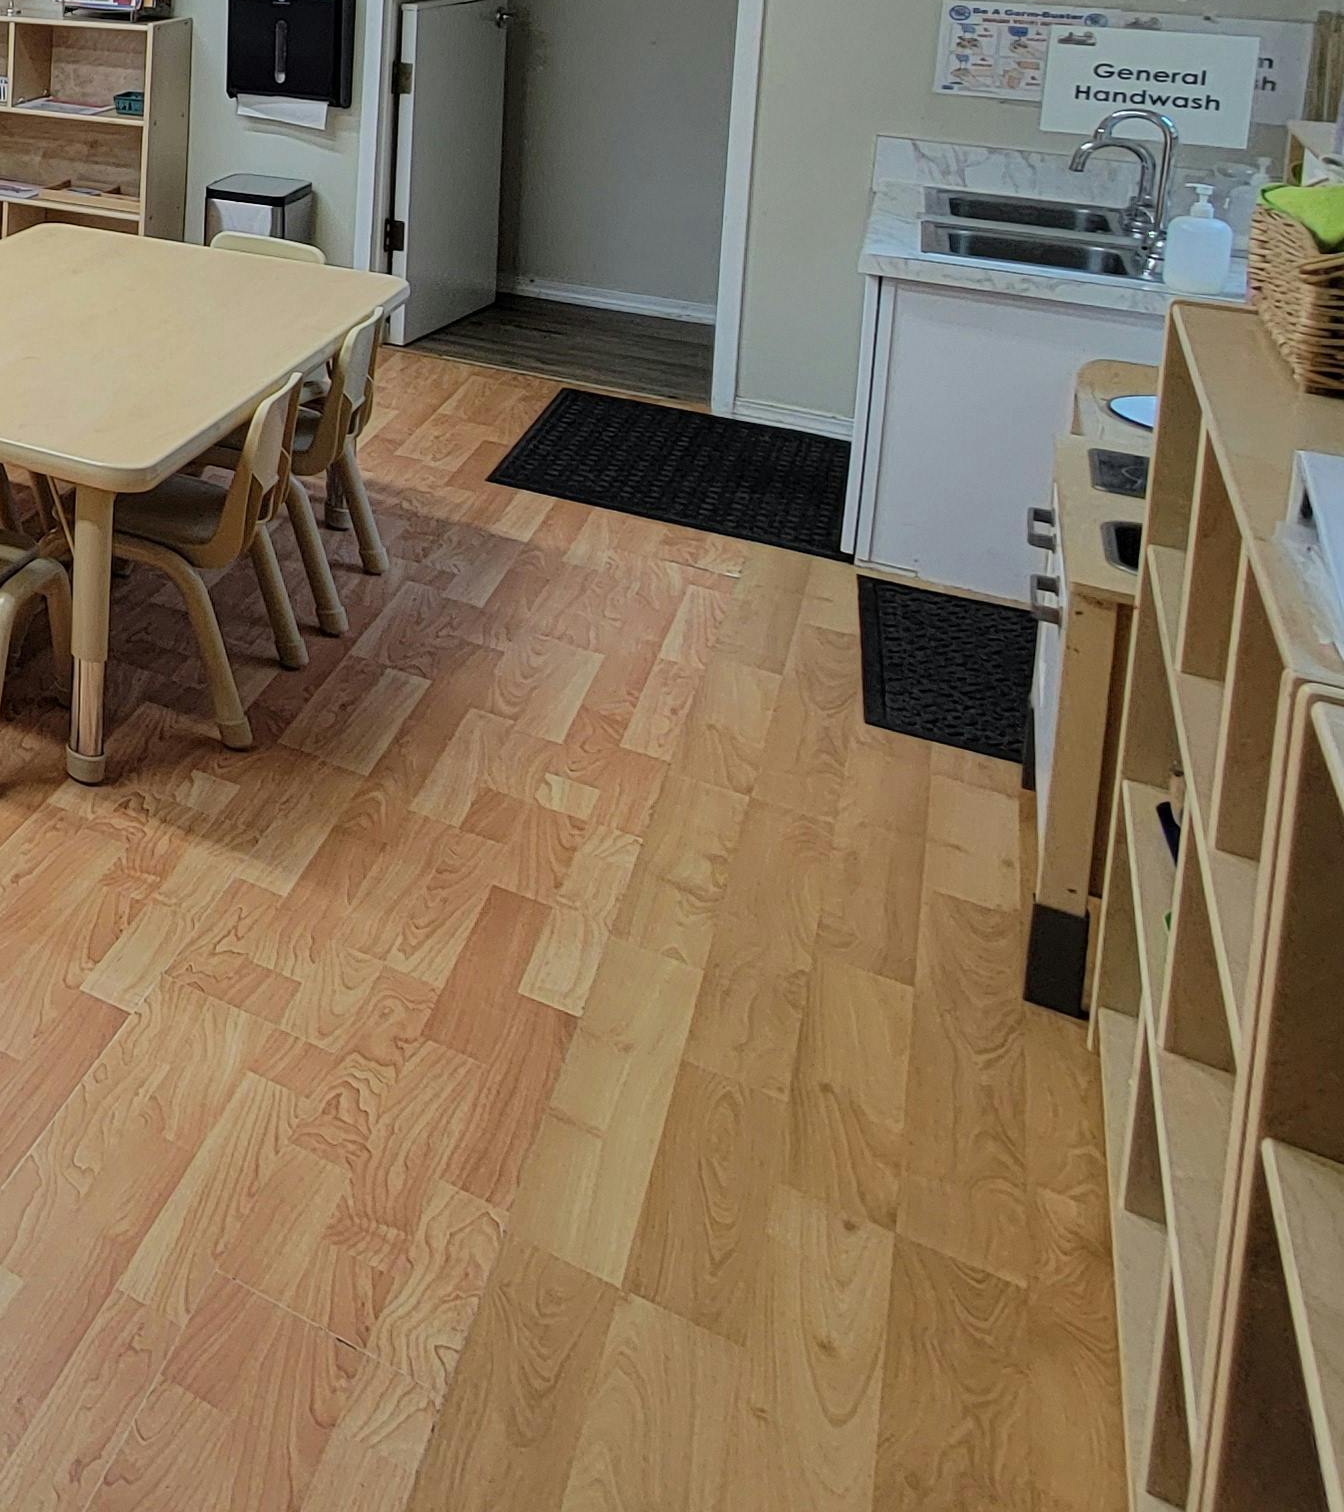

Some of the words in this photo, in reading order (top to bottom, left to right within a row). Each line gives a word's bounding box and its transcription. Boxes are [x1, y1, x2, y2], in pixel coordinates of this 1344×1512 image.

[972, 7, 989, 15] Be
[1004, 8, 1084, 20] Germ-Buster
[1093, 62, 1207, 86] General
[1074, 85, 1221, 111] Handwash
